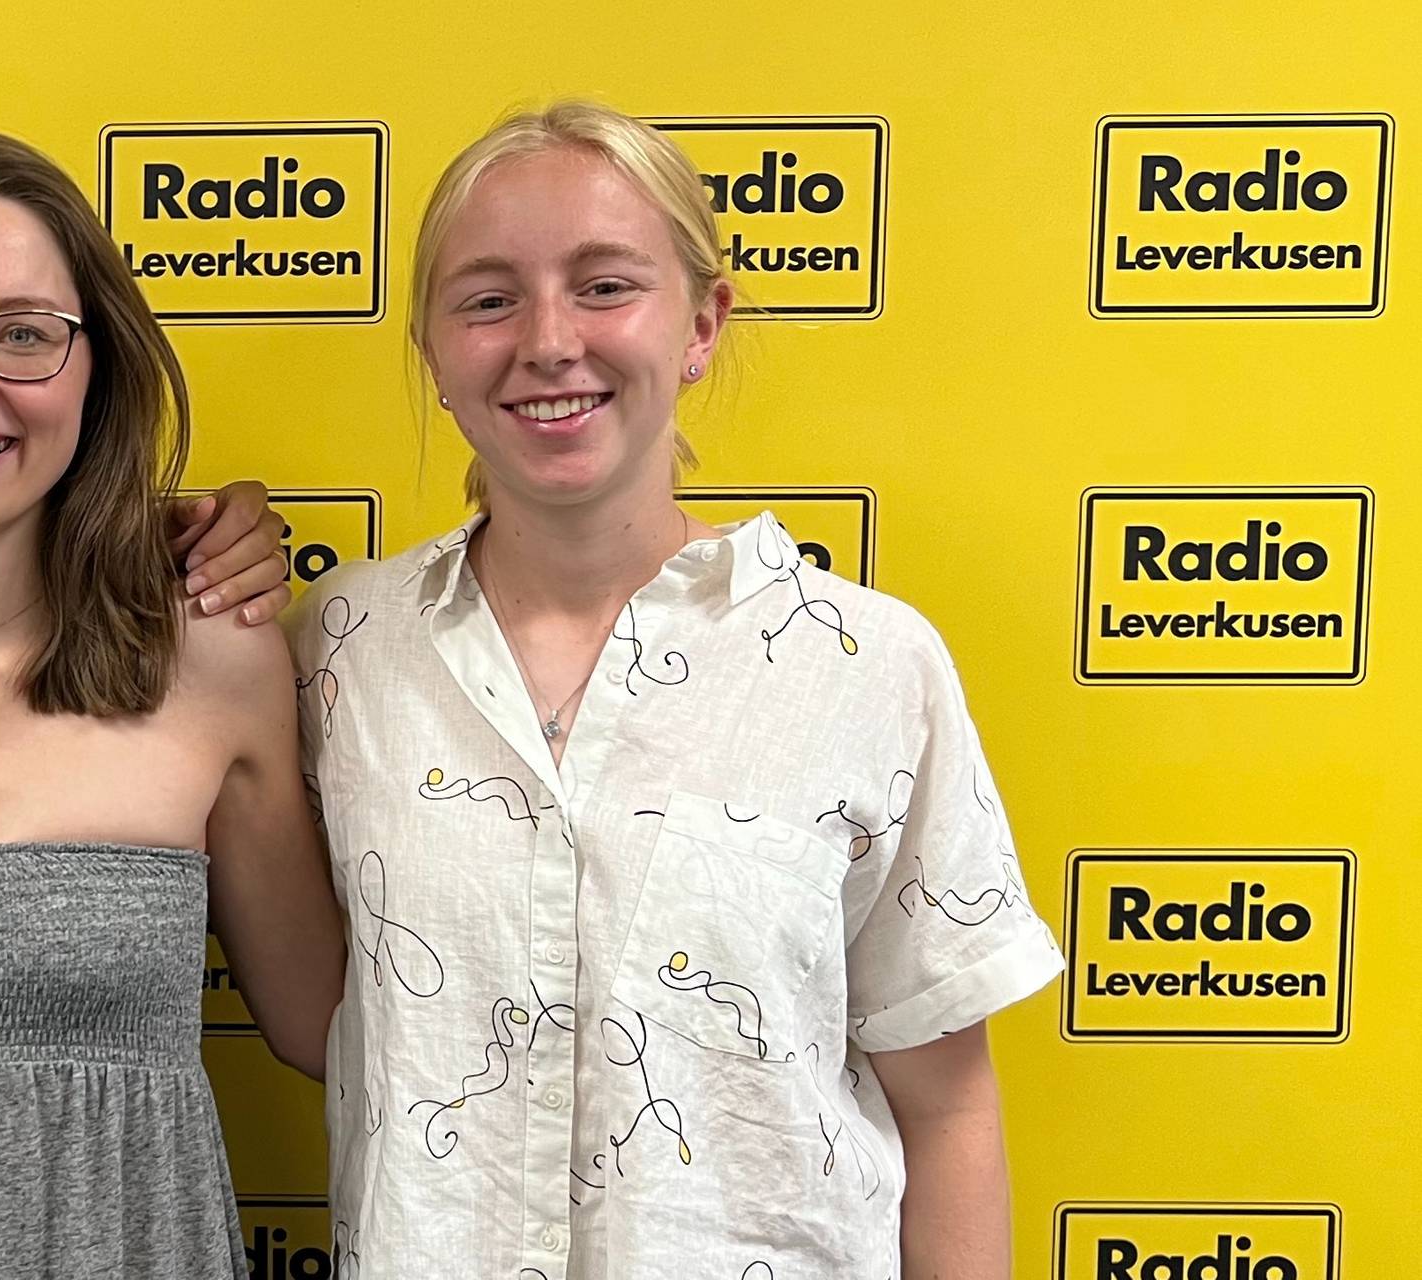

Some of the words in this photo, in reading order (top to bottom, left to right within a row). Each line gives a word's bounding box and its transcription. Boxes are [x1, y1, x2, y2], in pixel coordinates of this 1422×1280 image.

[143, 156, 345, 220] Radio
[697, 151, 844, 214] adio
[1139, 148, 1348, 213] Radio
[124, 239, 361, 278] Leverkusen
[1116, 231, 1362, 271] Leverkusen
[1123, 520, 1328, 582] Radio
[1100, 601, 1343, 638] Leverkusen
[1108, 881, 1311, 942] Radio
[1087, 960, 1326, 997] Leverkusen
[244, 1226, 332, 1280] dio
[1096, 1234, 1298, 1280] Radio
